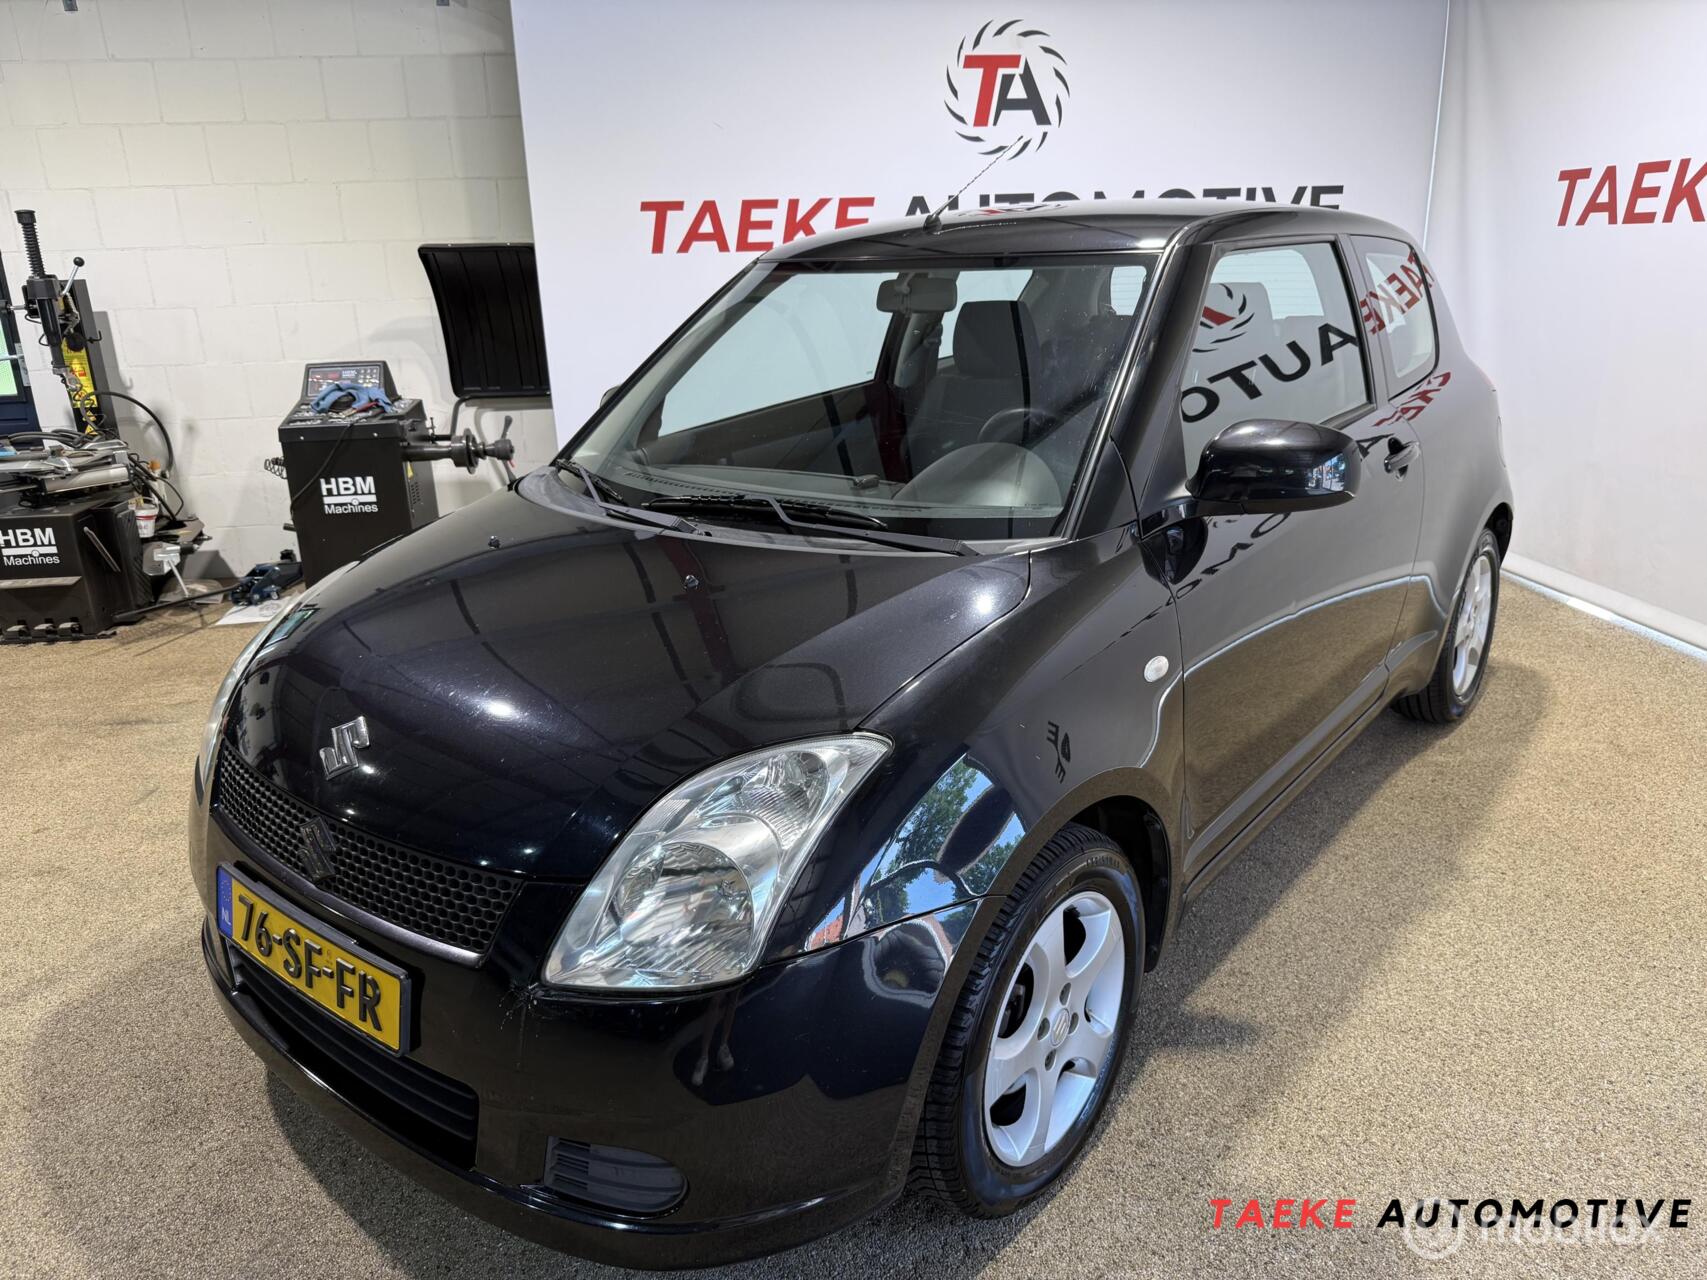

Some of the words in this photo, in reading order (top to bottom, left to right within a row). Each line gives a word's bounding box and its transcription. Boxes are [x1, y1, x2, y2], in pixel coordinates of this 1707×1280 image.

[963, 53, 1052, 127] TA
[1556, 157, 1707, 227] TAEK
[320, 476, 376, 496] HBM
[324, 503, 379, 515] Machines
[0, 527, 56, 547] HBM
[3, 554, 61, 566] Machines
[221, 907, 231, 927] NL
[238, 894, 383, 1032] 76-SF-FR
